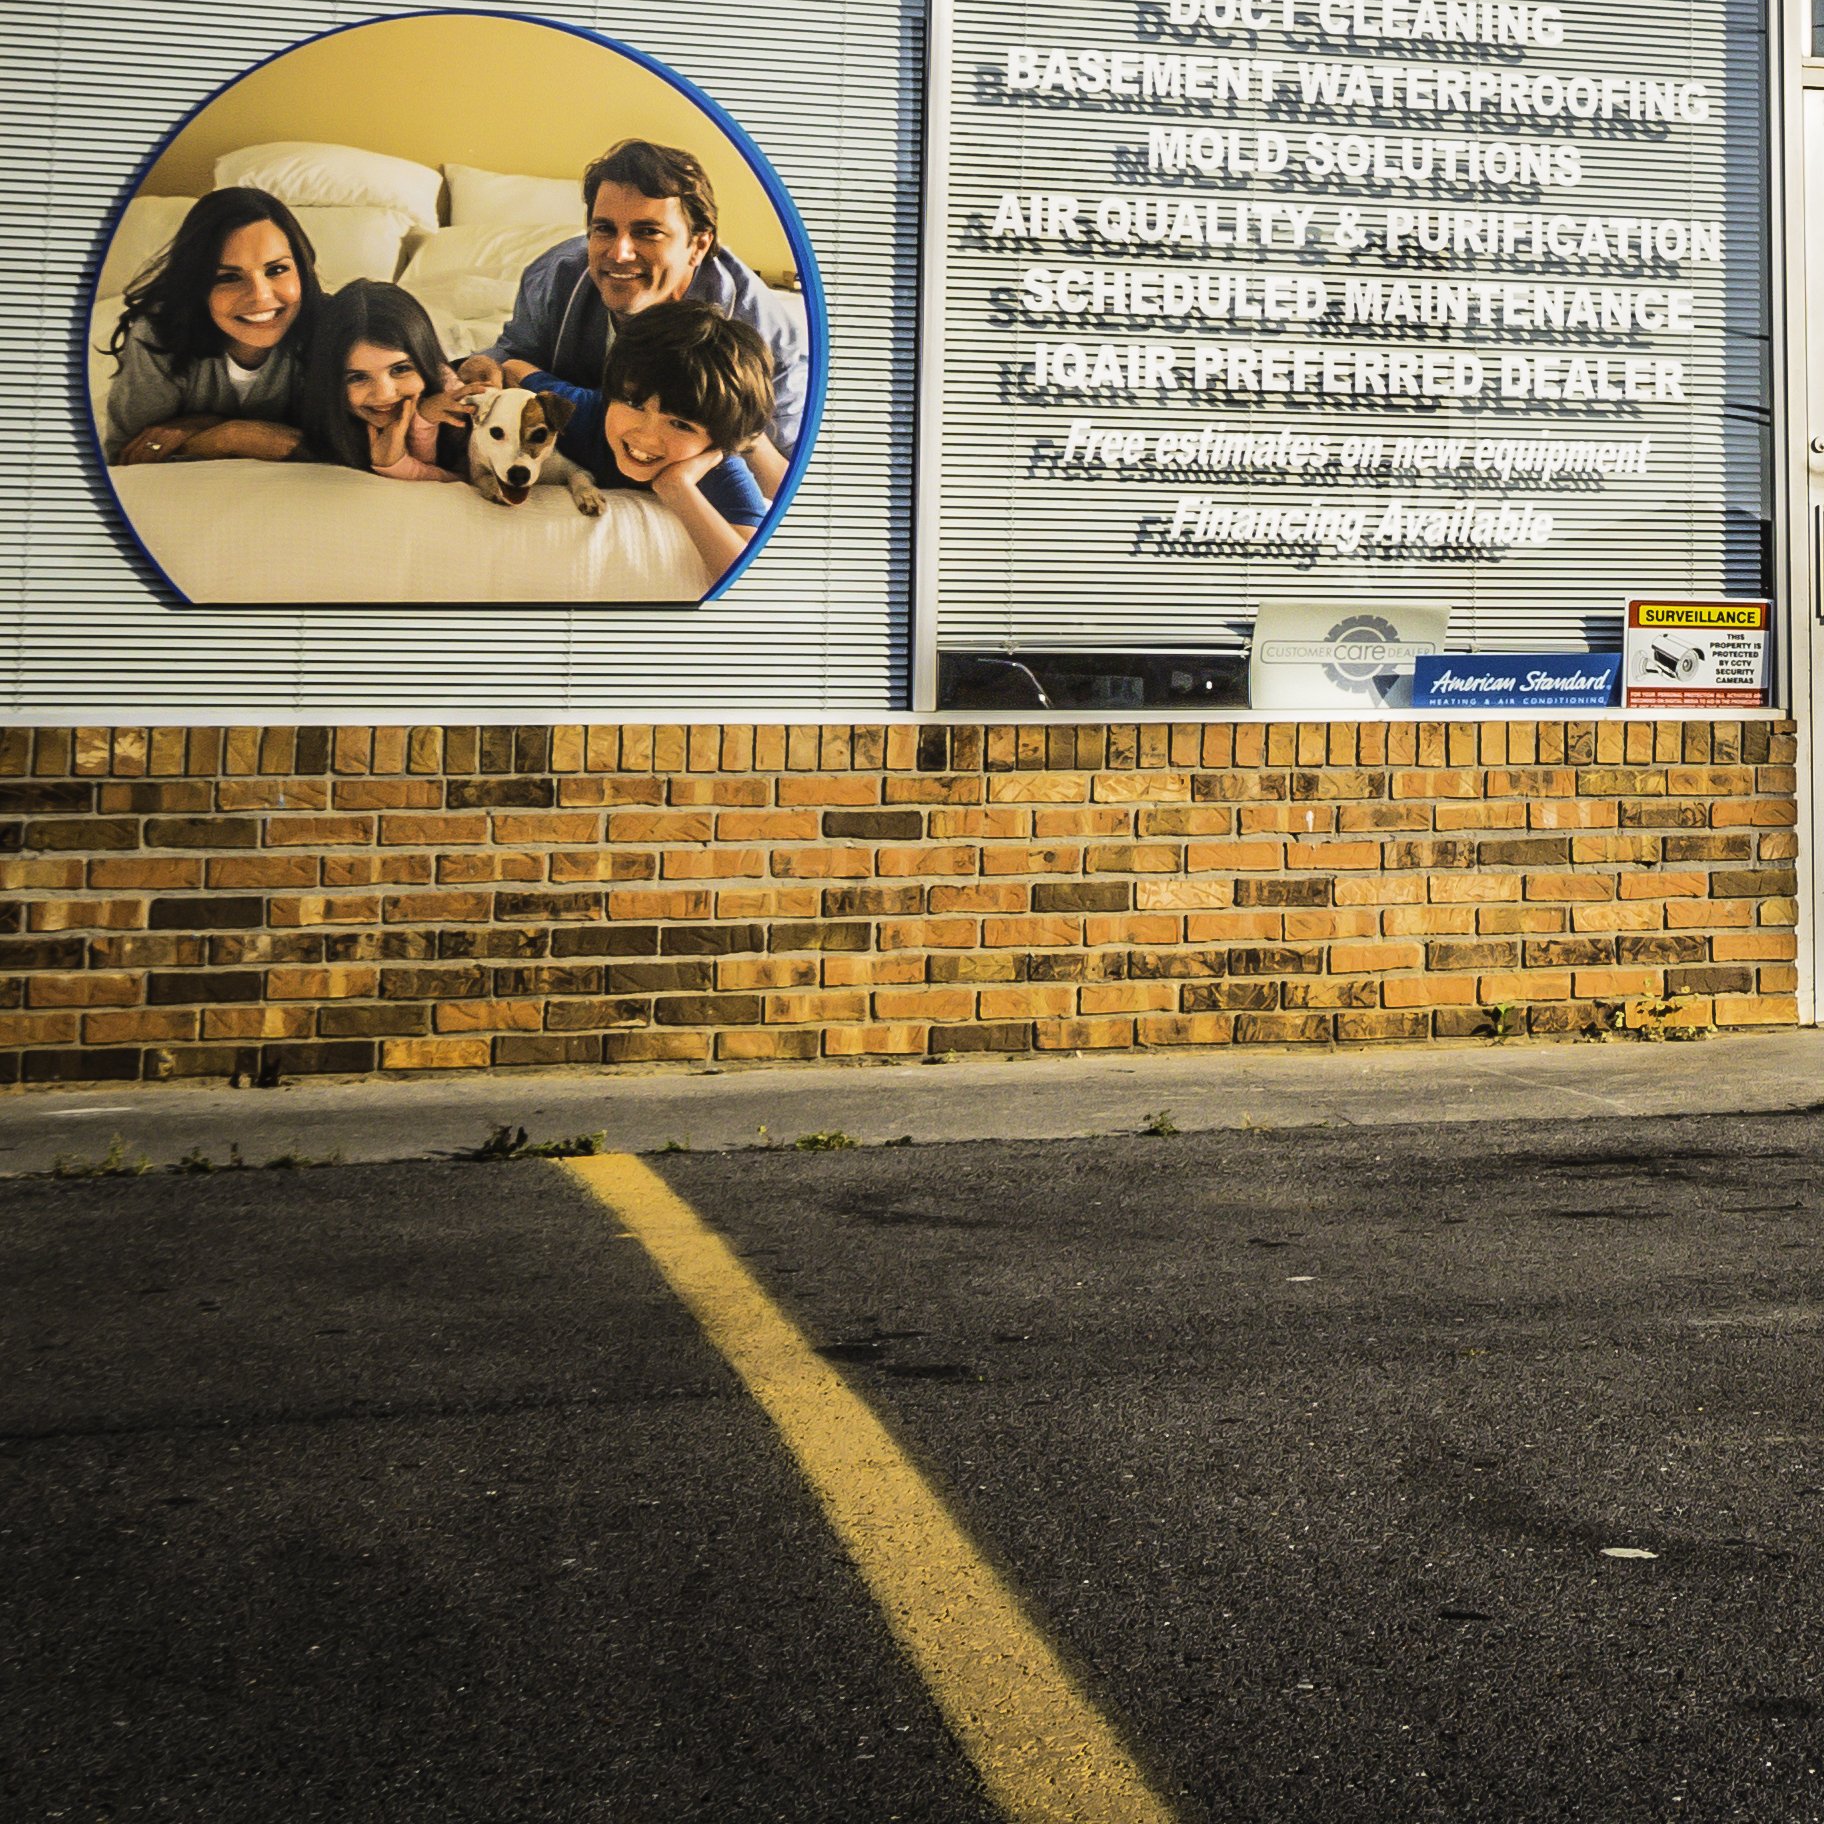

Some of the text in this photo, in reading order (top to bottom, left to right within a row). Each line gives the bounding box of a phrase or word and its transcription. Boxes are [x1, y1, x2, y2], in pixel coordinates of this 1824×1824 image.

[1007, 45, 1710, 124] BASEMENT WATERPROOFING
[1147, 126, 1582, 187] MOLD SOLUTIONS
[991, 193, 1721, 263] AIR QUALITY & PURIFICATION
[1022, 269, 1693, 332] SCHEDULED MAINTENANCE
[1034, 342, 1685, 402] IQAIR PREFERRED DEALER
[1063, 418, 1651, 482] Free estimates on new equipment
[1170, 496, 1554, 554] Financing Available
[1646, 610, 1755, 623] SURVEILLANCE
[1266, 640, 1431, 661] CUSTOMER care DEALER
[1430, 669, 1609, 694] American Standard
[1430, 697, 1476, 706] HEATING
[1498, 697, 1515, 706] AIR
[1523, 696, 1605, 706] CONDITIONING
